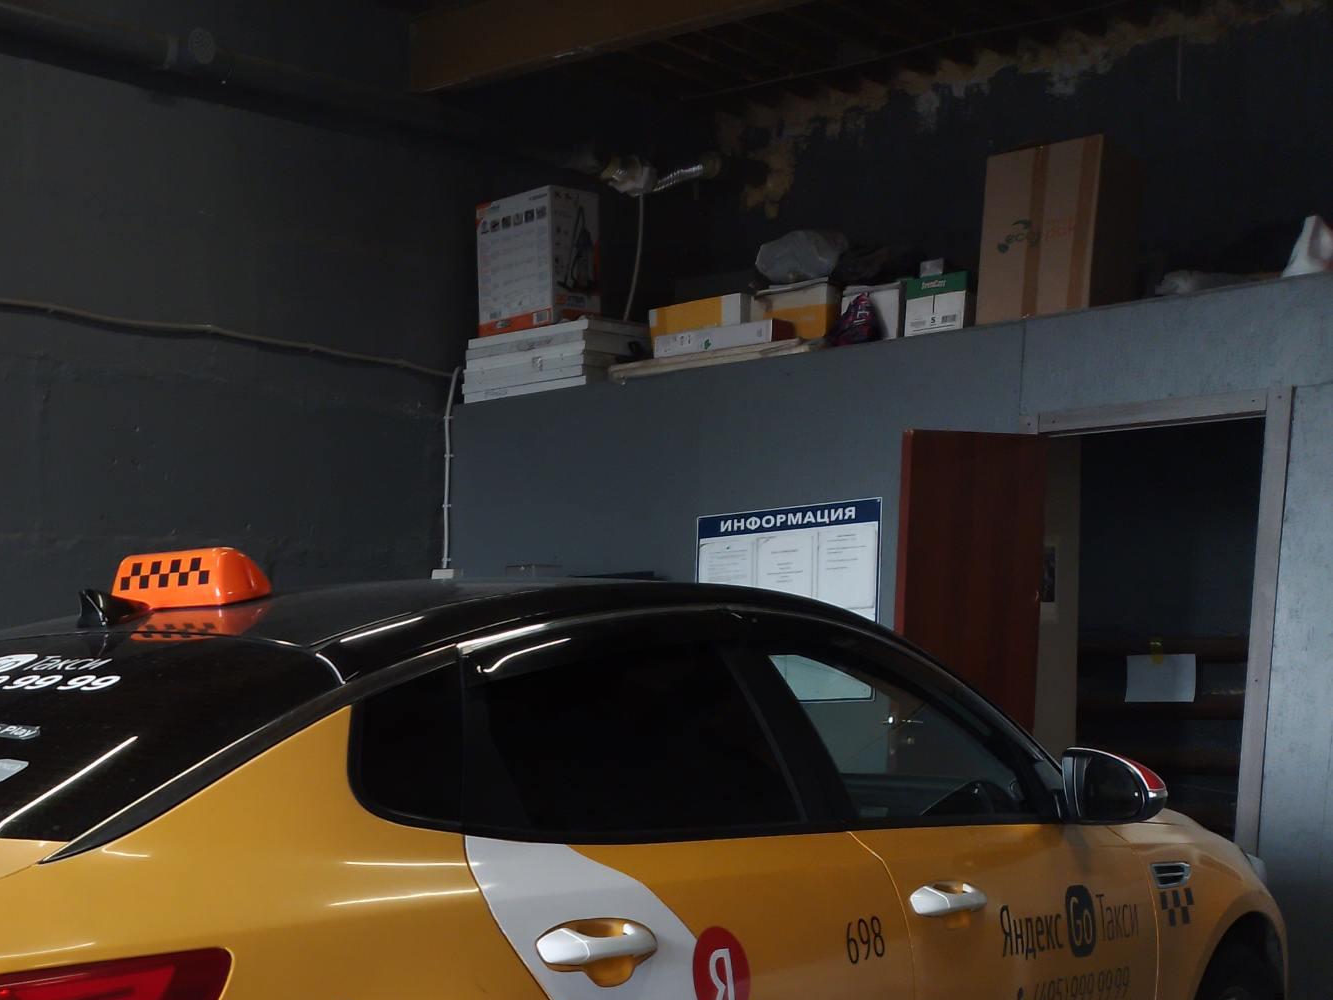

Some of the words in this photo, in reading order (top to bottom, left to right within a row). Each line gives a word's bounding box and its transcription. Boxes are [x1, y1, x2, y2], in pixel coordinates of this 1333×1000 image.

[719, 506, 856, 533] ИНФОРМАЦИЯ
[23, 655, 113, 671] Такси
[2, 675, 64, 690] 99
[57, 675, 122, 691] 99
[0, 725, 38, 738] Play
[847, 916, 885, 964] 698
[1000, 905, 1064, 960] Яндекс
[1069, 896, 1094, 946] Go
[1095, 893, 1140, 942] Такси
[1115, 966, 1130, 999] 99
